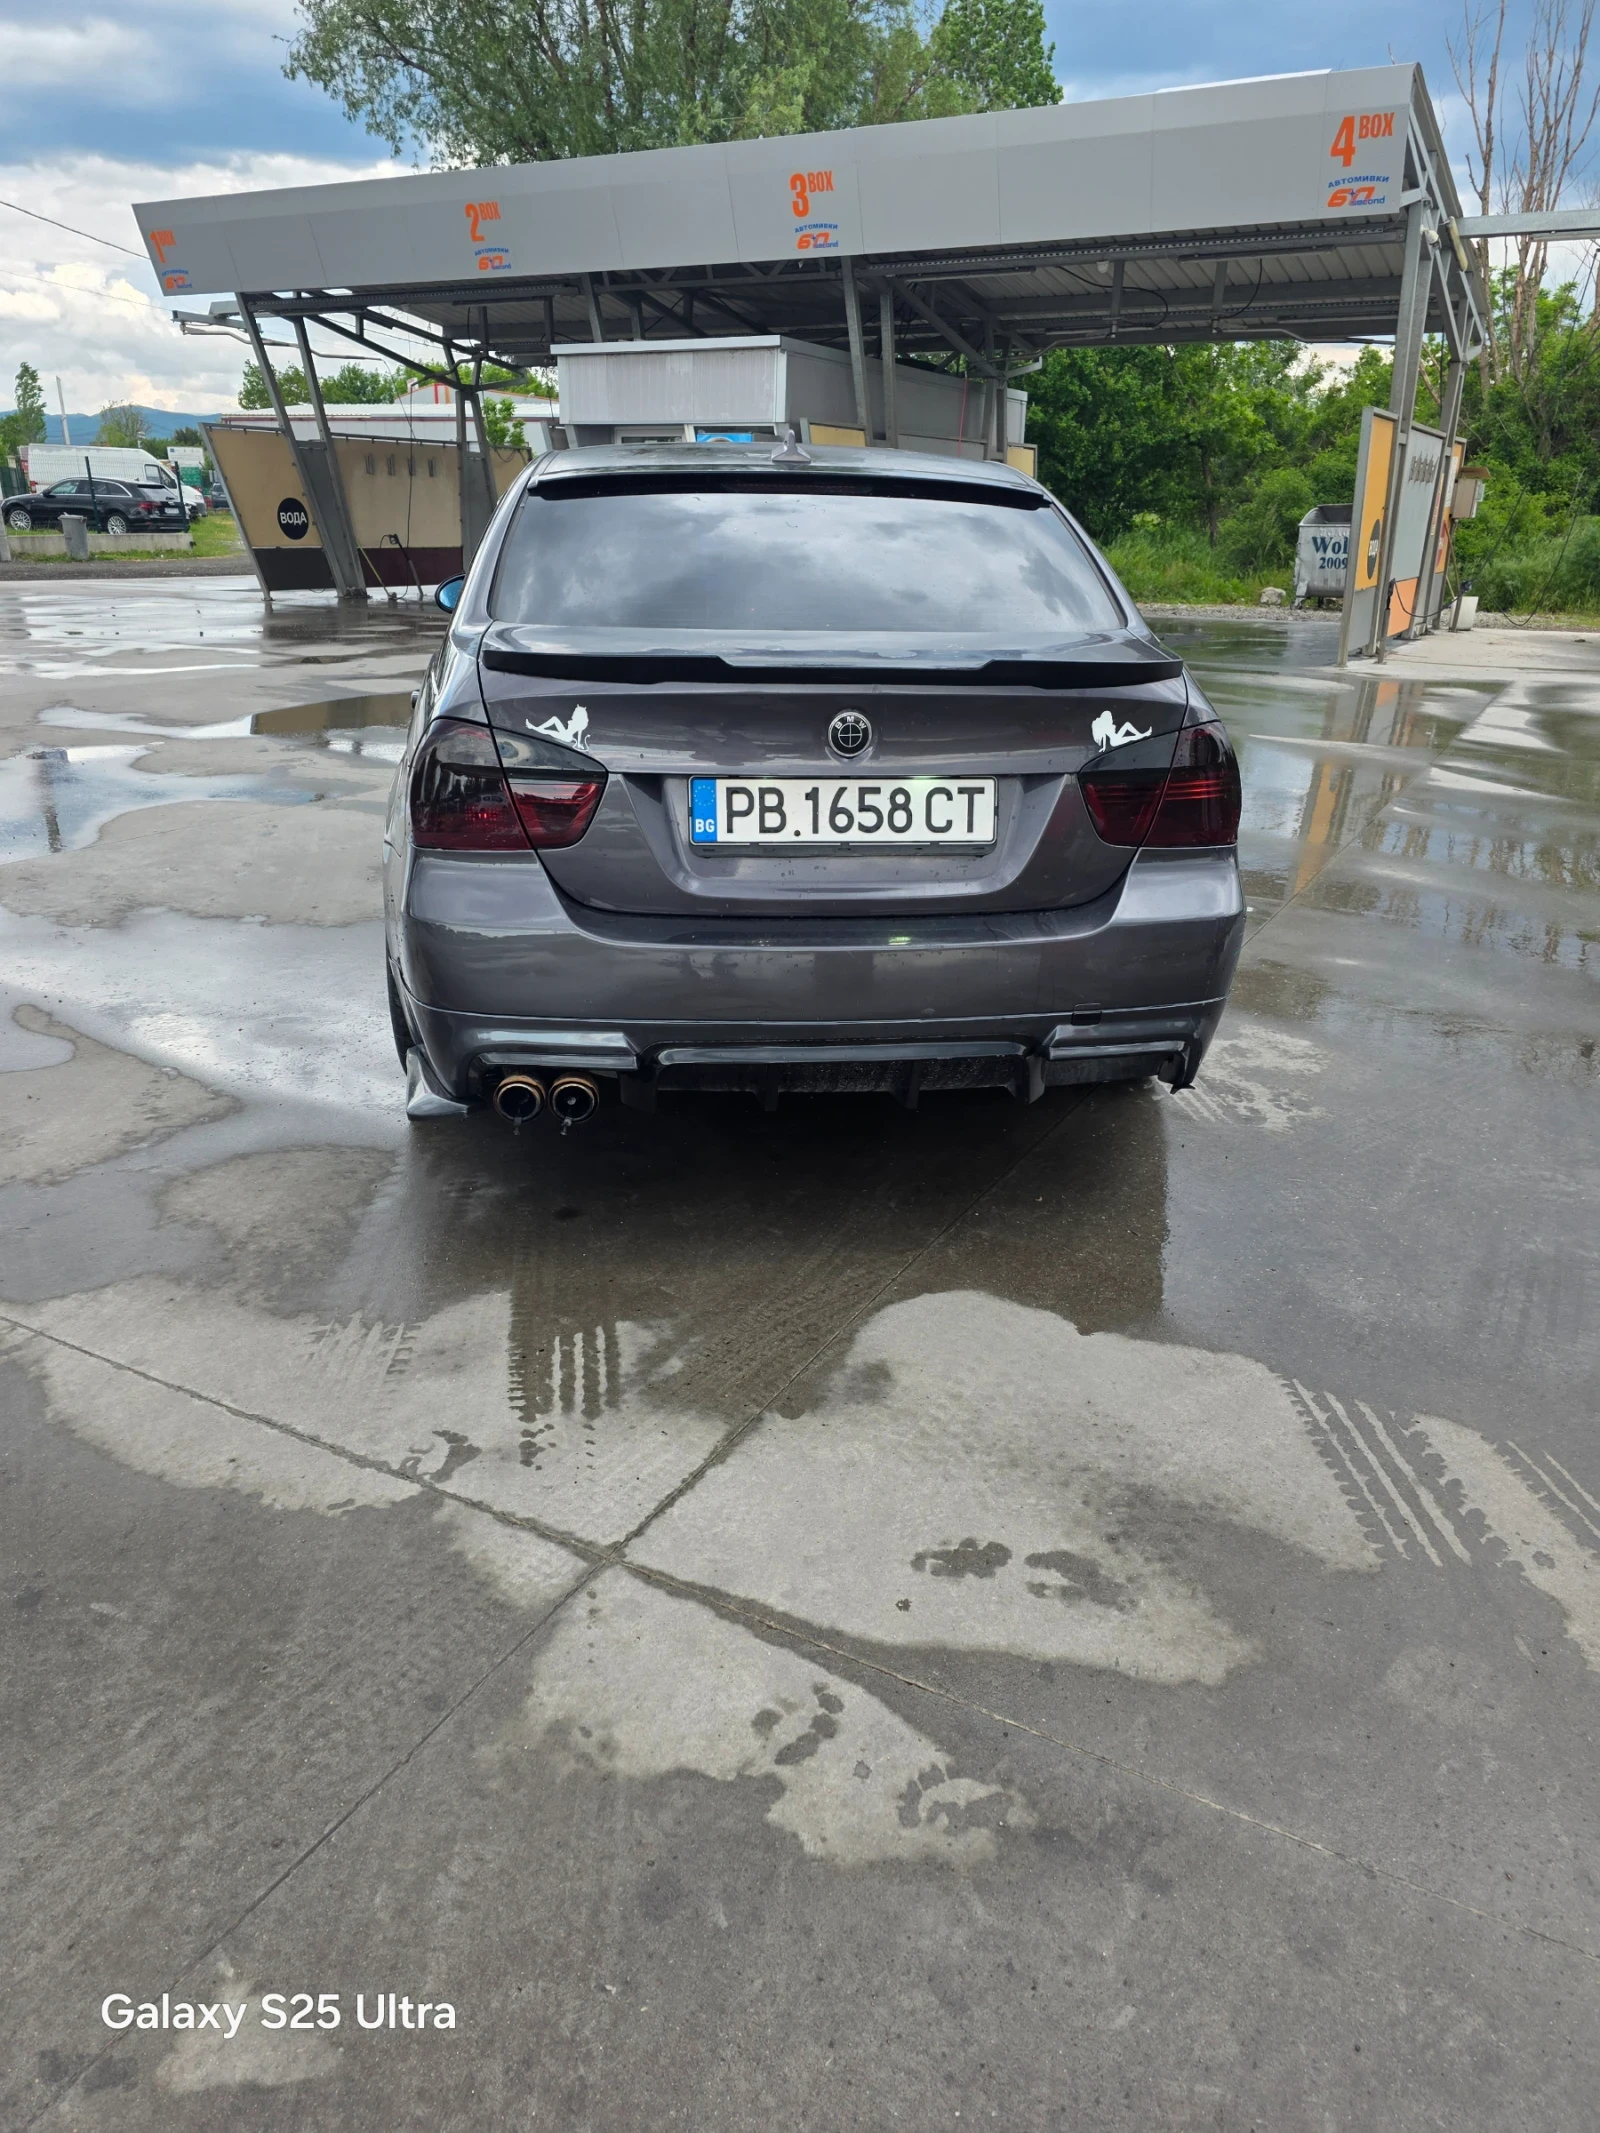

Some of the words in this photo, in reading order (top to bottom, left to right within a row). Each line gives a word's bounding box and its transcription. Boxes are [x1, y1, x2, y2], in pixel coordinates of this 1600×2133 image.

[1330, 115, 1356, 168] 4
[1358, 112, 1394, 139] BOX
[1327, 175, 1389, 188] АВТОМИВКИ
[790, 173, 810, 218] 3
[807, 170, 834, 193] BOX
[1350, 196, 1385, 206] second
[465, 203, 485, 242] 2
[479, 201, 502, 221] BOX
[794, 223, 838, 233] АВТОМИВКИ
[151, 231, 166, 263] 1
[280, 512, 307, 525] ВОДА
[834, 715, 867, 730] BMW
[725, 786, 787, 834] PB
[804, 786, 914, 834] 1658
[925, 786, 985, 834] CT
[695, 818, 715, 833] BG
